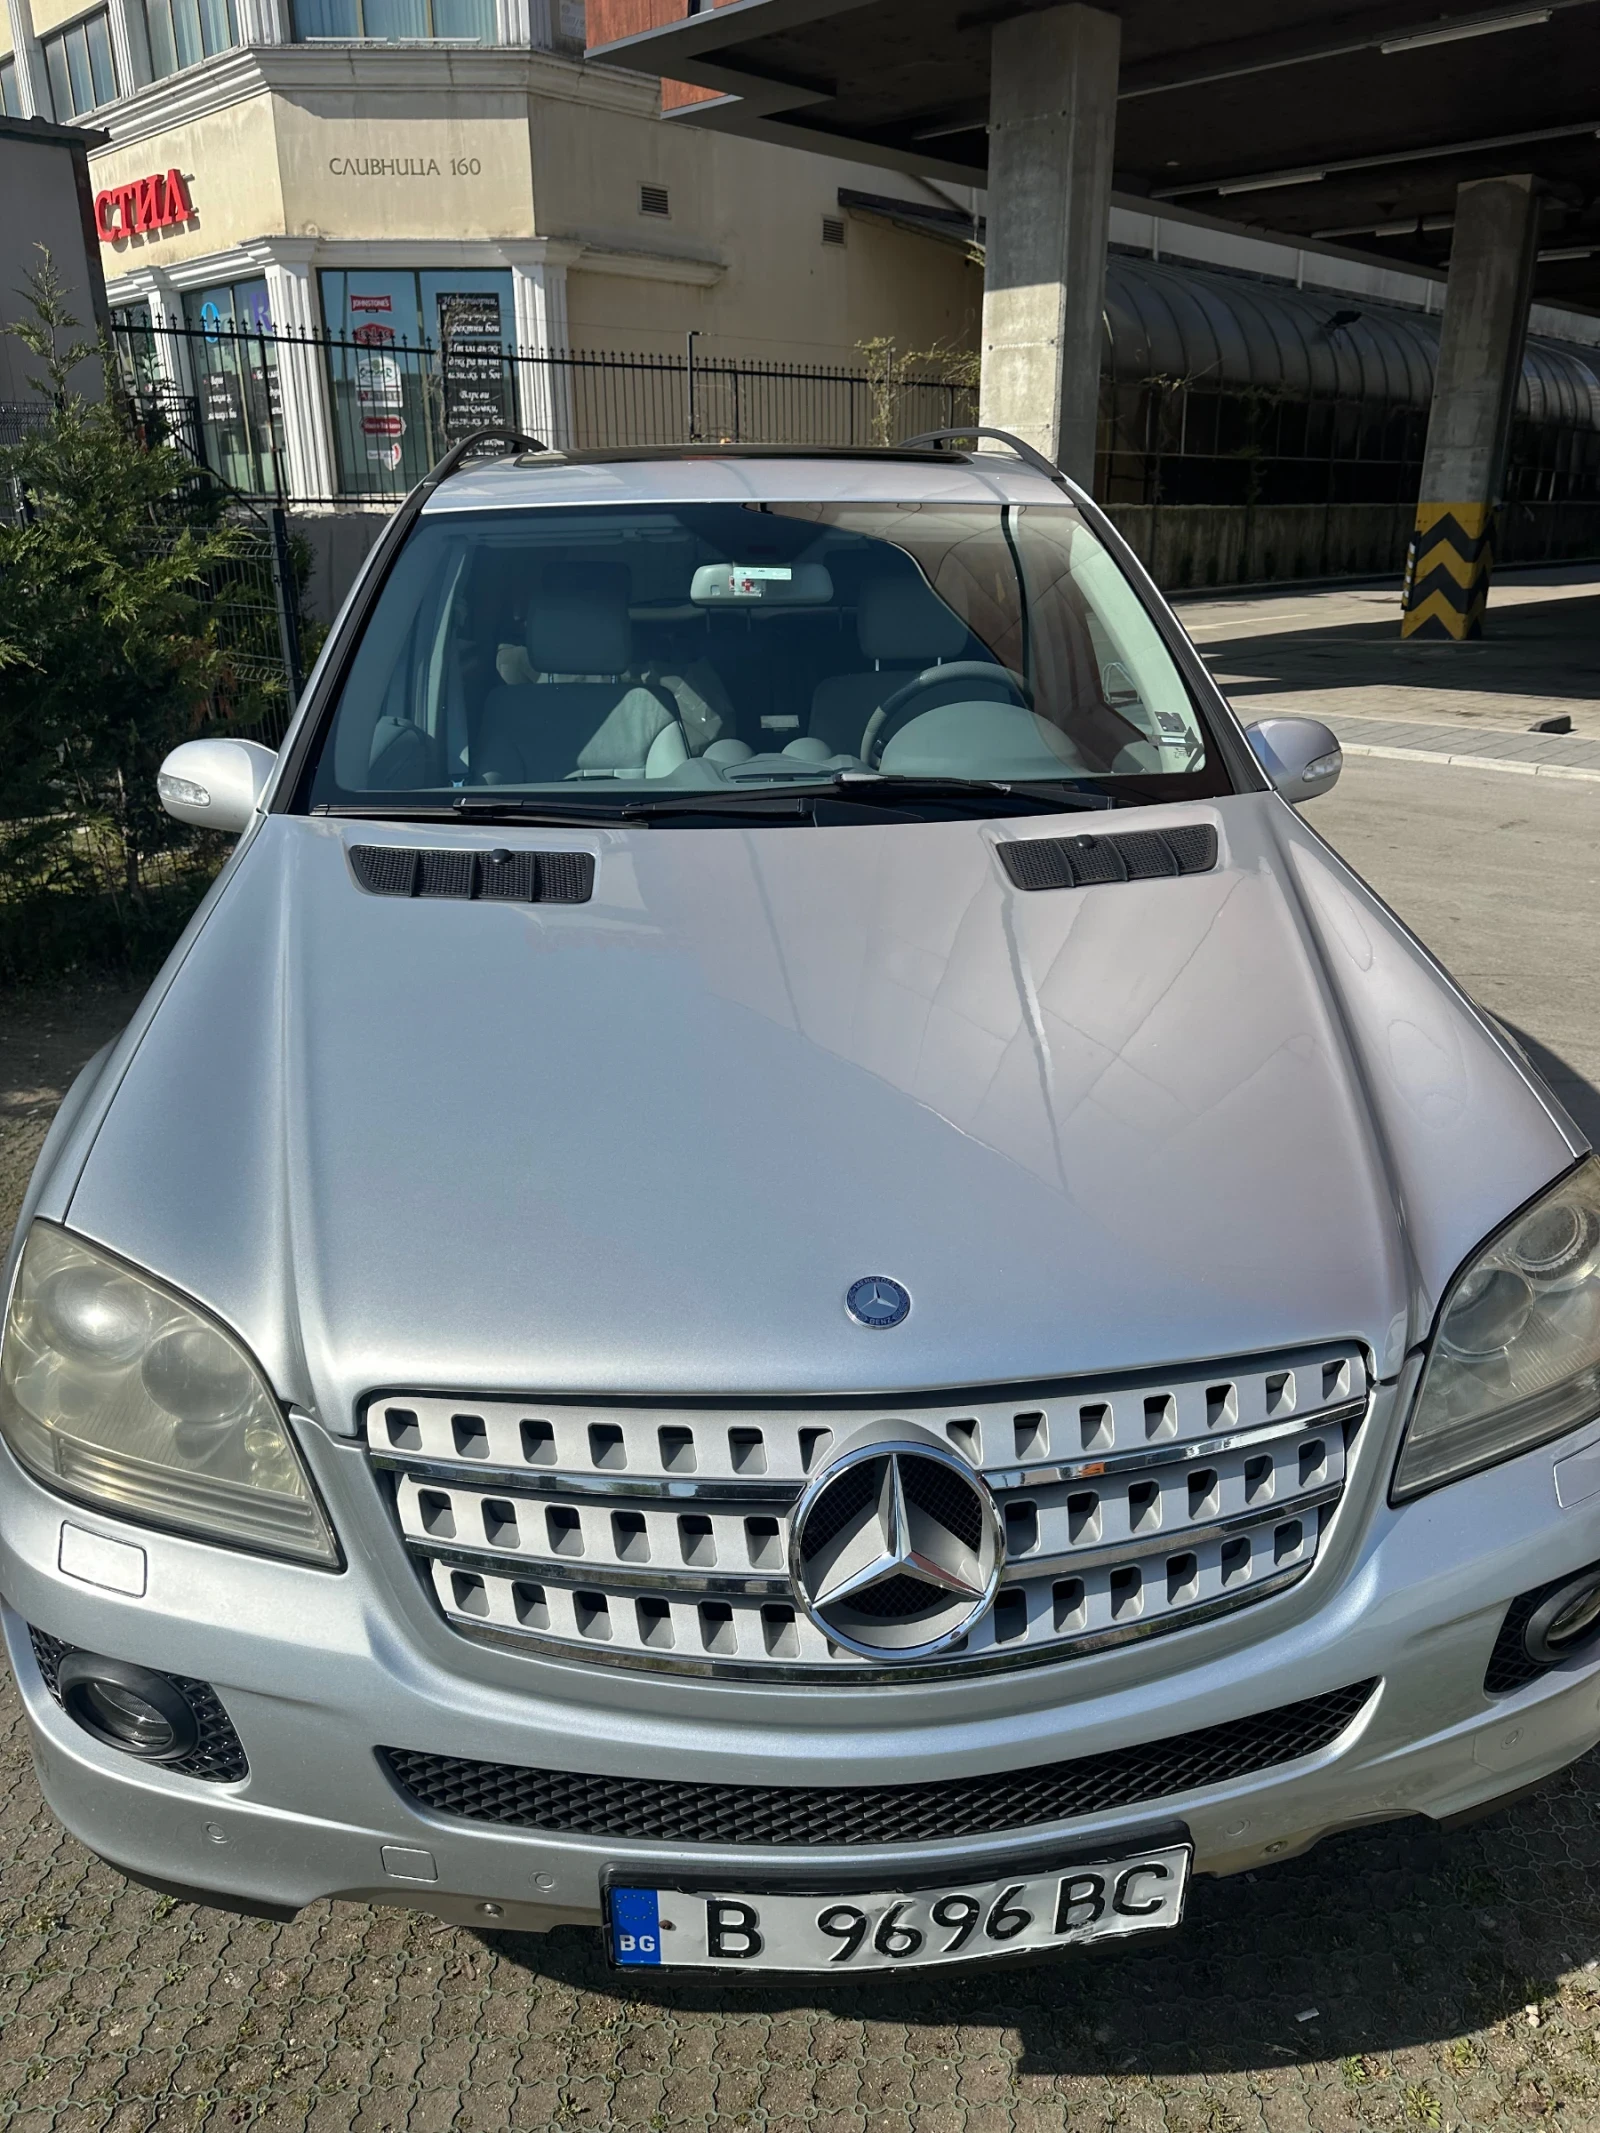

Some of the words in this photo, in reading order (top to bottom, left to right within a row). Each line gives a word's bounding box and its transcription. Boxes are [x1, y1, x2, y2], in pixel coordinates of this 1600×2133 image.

[329, 157, 440, 176] СЛИВНИЦА
[450, 157, 481, 176] 160
[95, 168, 189, 243] СТИЛ
[707, 1899, 764, 1959] B
[816, 1882, 1032, 1963] 9696
[1053, 1862, 1170, 1936] BC
[620, 1934, 656, 1953] BG
